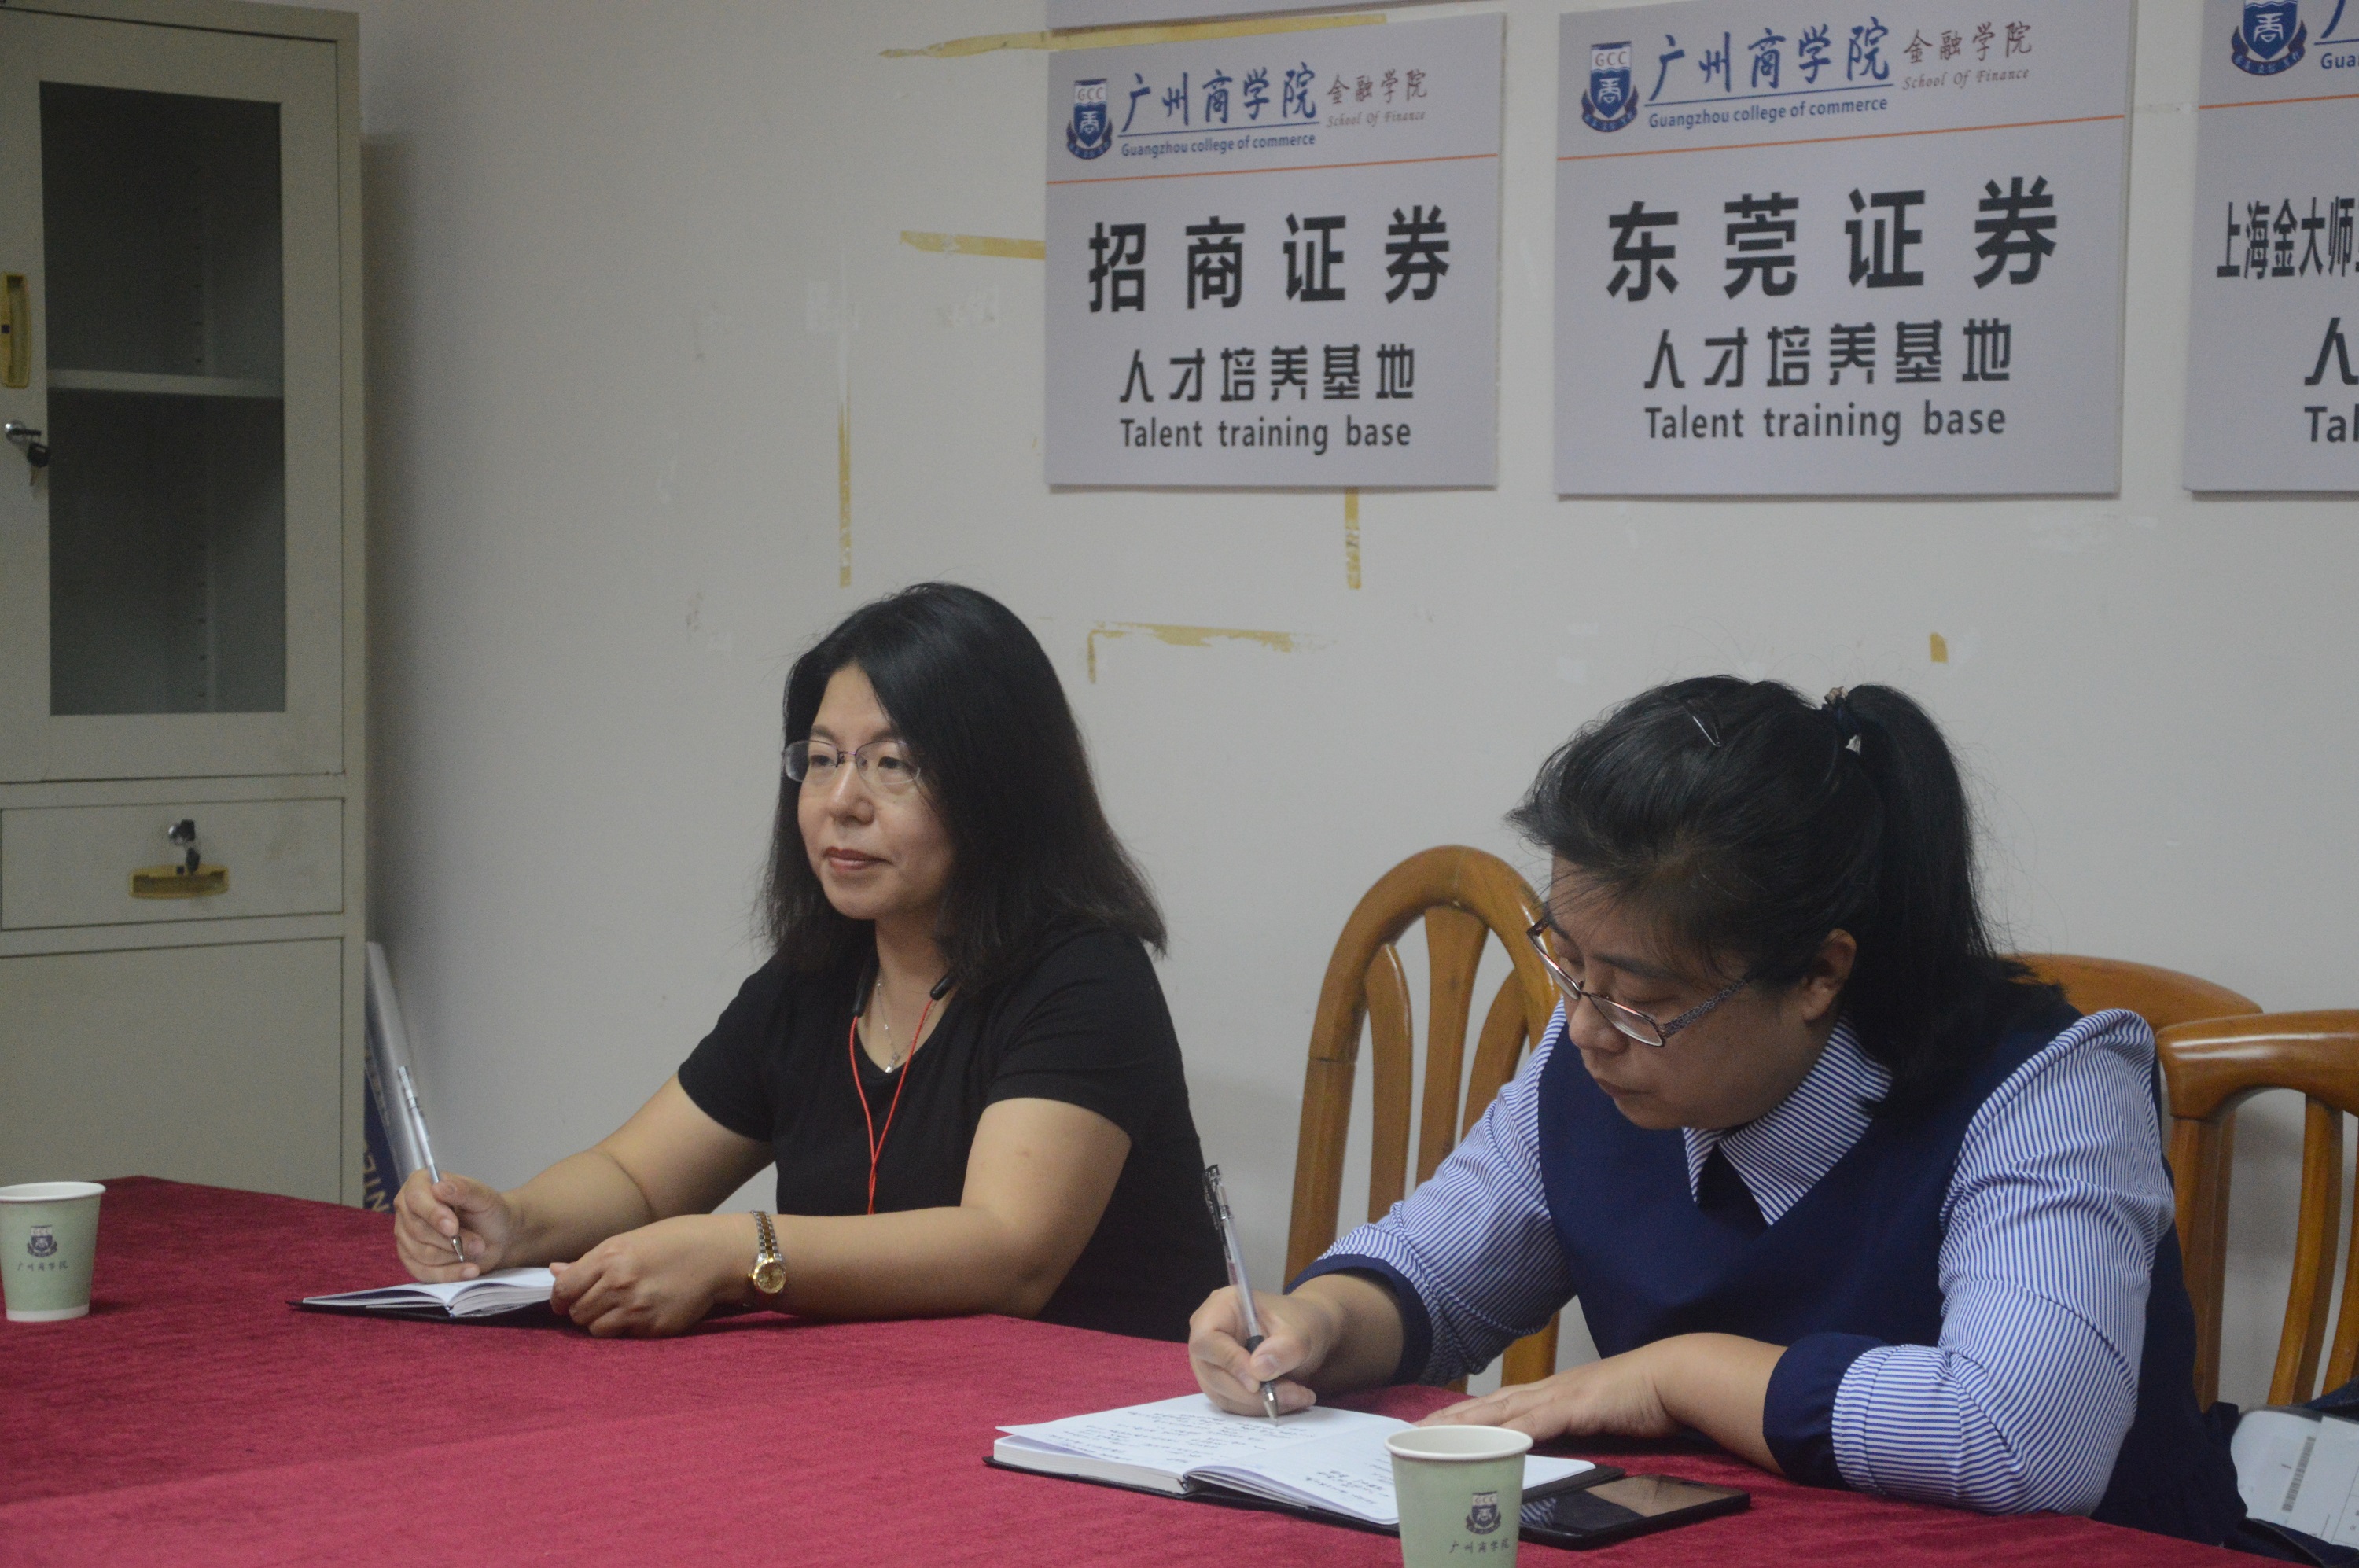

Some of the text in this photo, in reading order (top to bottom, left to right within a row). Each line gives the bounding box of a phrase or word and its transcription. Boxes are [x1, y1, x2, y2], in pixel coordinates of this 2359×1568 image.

[1595, 51, 1627, 67] GCC
[1649, 17, 1890, 101] 广州商学院
[1904, 21, 2032, 64] 金融学院
[2320, 53, 2359, 69] Gua
[1077, 87, 1104, 101] GCC
[1121, 62, 1316, 132] 广州商学院
[1327, 69, 1427, 104] 金融学院
[1902, 69, 2029, 90] School Of Finance
[1649, 109, 1729, 130] Guangzhou
[1733, 105, 1786, 123] college
[1790, 101, 1805, 117] of
[1809, 98, 1887, 116] commerce
[1121, 141, 1188, 159] Guangzhou
[1191, 138, 1235, 154] college
[1237, 135, 1250, 149] of
[1252, 134, 1316, 149] commerce
[1088, 205, 1449, 313] 招商证券
[1606, 175, 2057, 302] 东莞证券
[2217, 196, 2359, 280] 上海金大师
[1120, 344, 1414, 403] 人才培养基地
[1644, 318, 2011, 389] 人才培养基地
[1120, 414, 1411, 456] Talent training base
[1644, 399, 2005, 447] Talent training base
